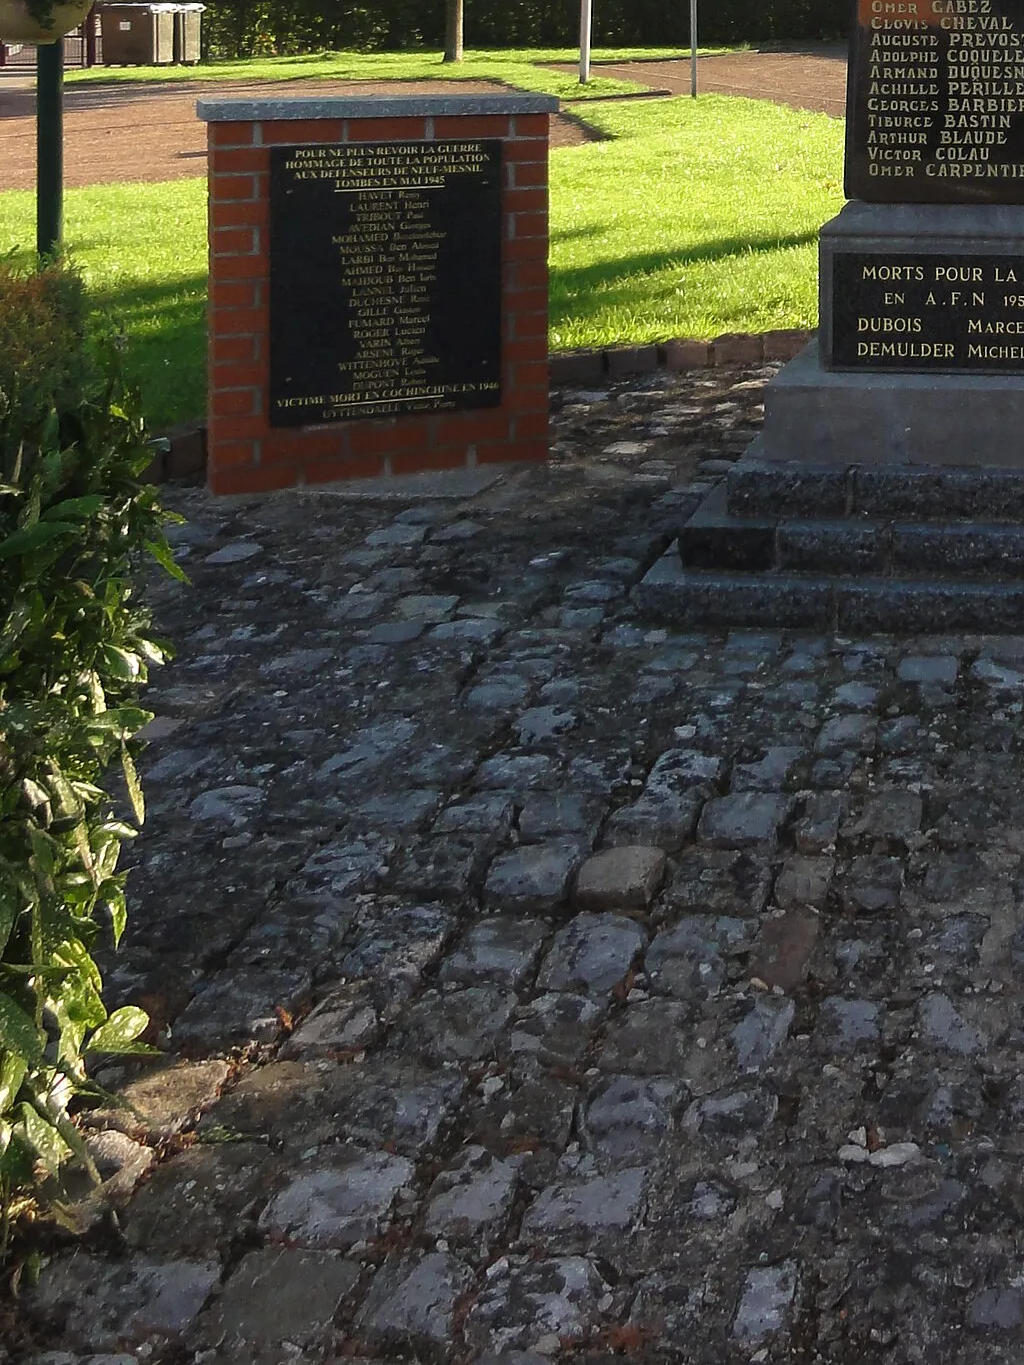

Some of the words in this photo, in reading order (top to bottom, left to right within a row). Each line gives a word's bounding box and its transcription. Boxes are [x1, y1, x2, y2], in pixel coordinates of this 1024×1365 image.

[940, 16, 1013, 30] CHEVAL
[944, 115, 1011, 128] BASTIN
[940, 131, 1007, 144] BLAUDE
[295, 149, 326, 158] POUR
[329, 148, 345, 157] NE
[346, 147, 374, 156] PLUS
[376, 146, 418, 156] REVOIR
[421, 145, 435, 154] LA
[437, 143, 482, 154] GUERRE
[936, 147, 990, 160] COLAU
[286, 159, 345, 169] HOMMAGE
[349, 157, 365, 167] DE
[367, 156, 402, 166] TOUTE
[406, 155, 420, 164] LA
[423, 153, 490, 164] POPULATION
[294, 170, 317, 180] AUX
[394, 166, 408, 175] DE
[411, 163, 483, 174] NEUF-MESNIL
[383, 177, 398, 187] EN
[400, 176, 422, 186] MAI
[424, 175, 445, 184] 1945
[862, 266, 924, 281] MORTS
[935, 267, 983, 282] POUR
[995, 268, 1018, 282] LA
[884, 292, 905, 305] EN
[858, 318, 922, 332] DUBOIS
[858, 343, 955, 358] DEMULDER
